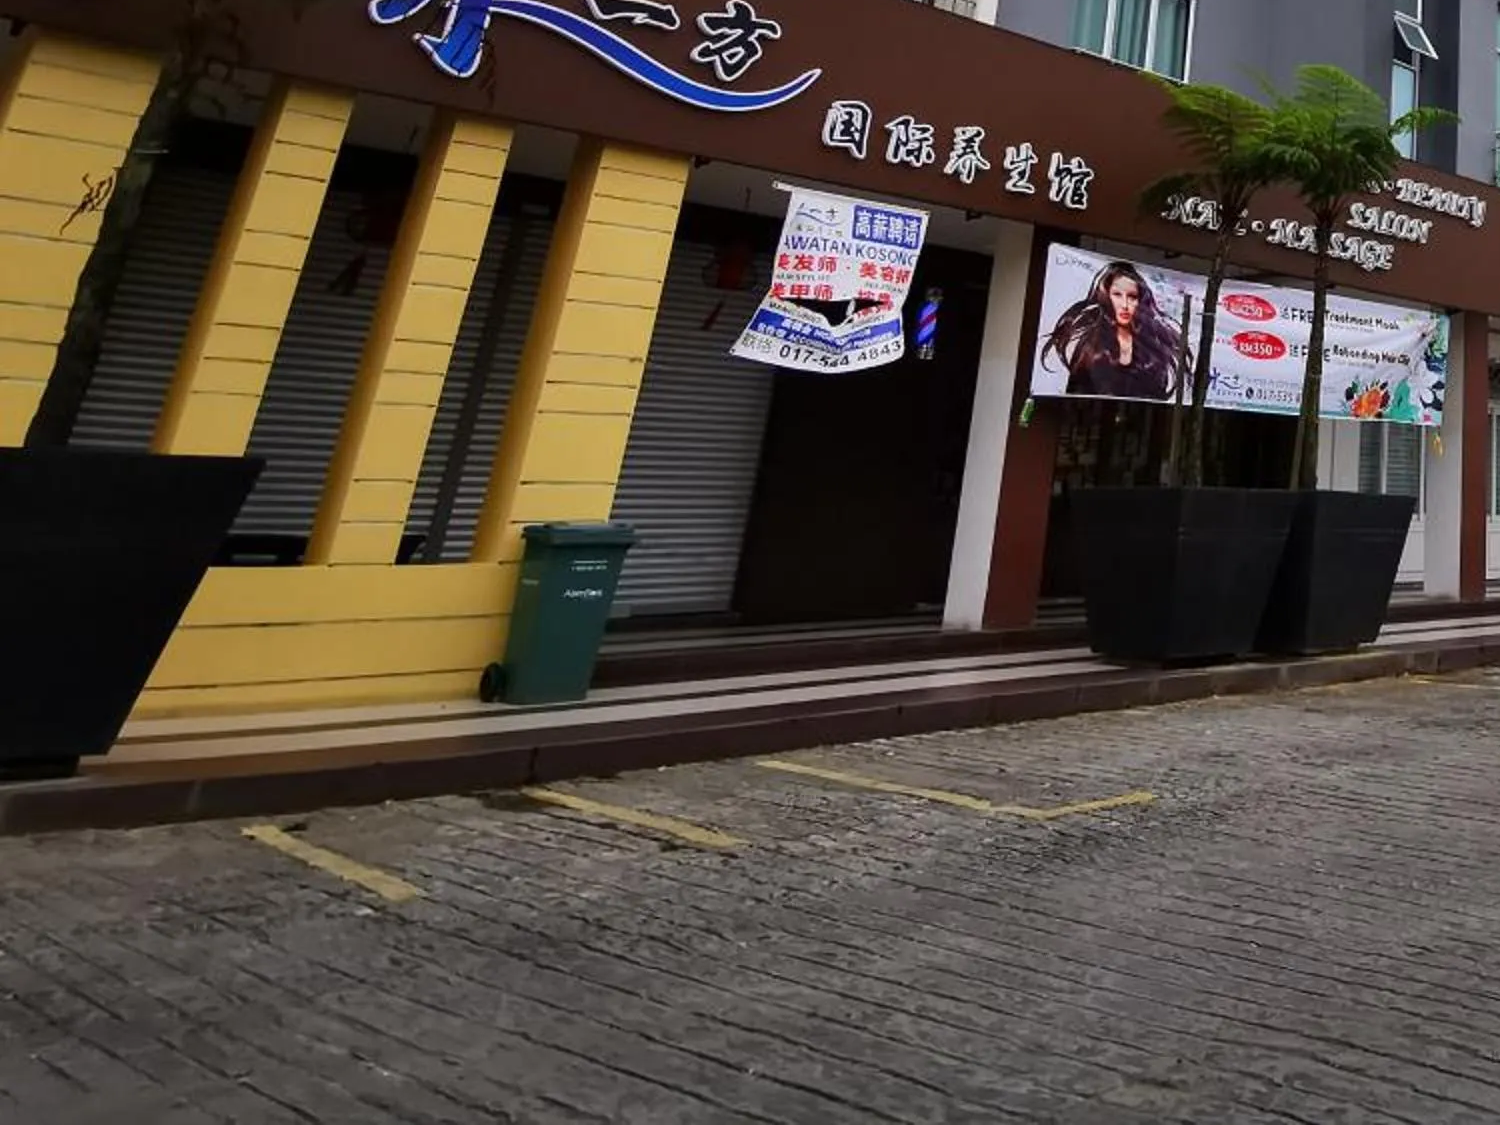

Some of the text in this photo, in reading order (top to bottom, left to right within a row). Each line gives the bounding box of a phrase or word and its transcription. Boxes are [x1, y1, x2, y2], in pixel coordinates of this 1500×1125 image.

[821, 100, 1095, 210] 国际养生馆
[1346, 202, 1433, 244] SALON
[1395, 178, 1487, 227] BEAUTY
[1266, 218, 1395, 272] MASAGE
[1291, 308, 1315, 324] FRE
[1239, 340, 1273, 356] RM350
